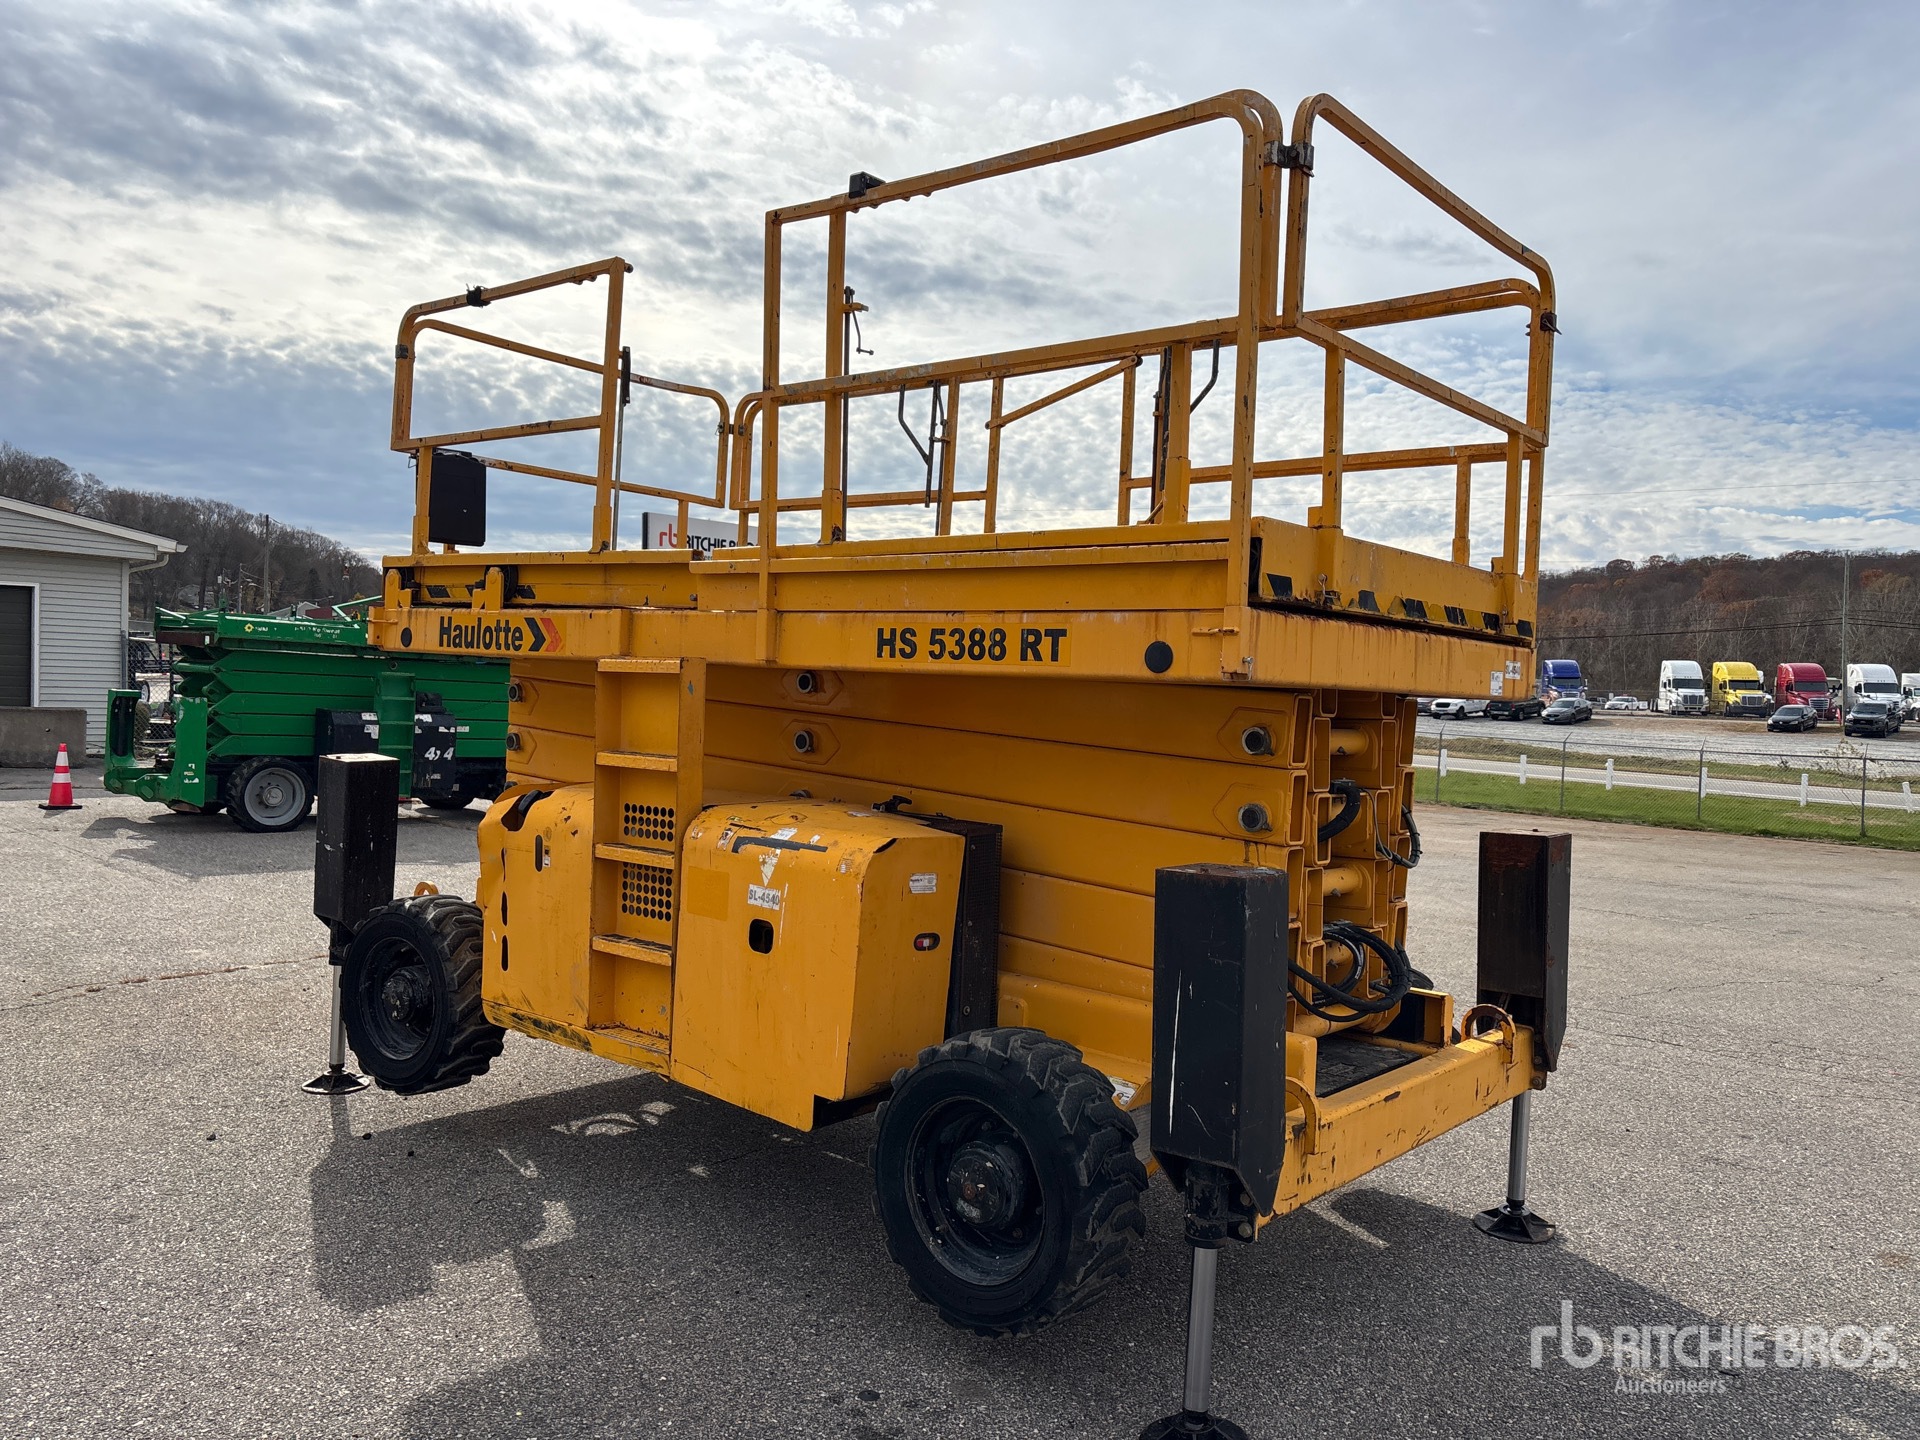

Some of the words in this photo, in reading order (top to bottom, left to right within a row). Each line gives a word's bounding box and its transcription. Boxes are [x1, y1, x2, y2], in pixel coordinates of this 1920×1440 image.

[439, 616, 524, 652] Haulotte
[877, 627, 917, 660] HS
[928, 628, 1007, 662] 5388
[1020, 628, 1067, 662] RT
